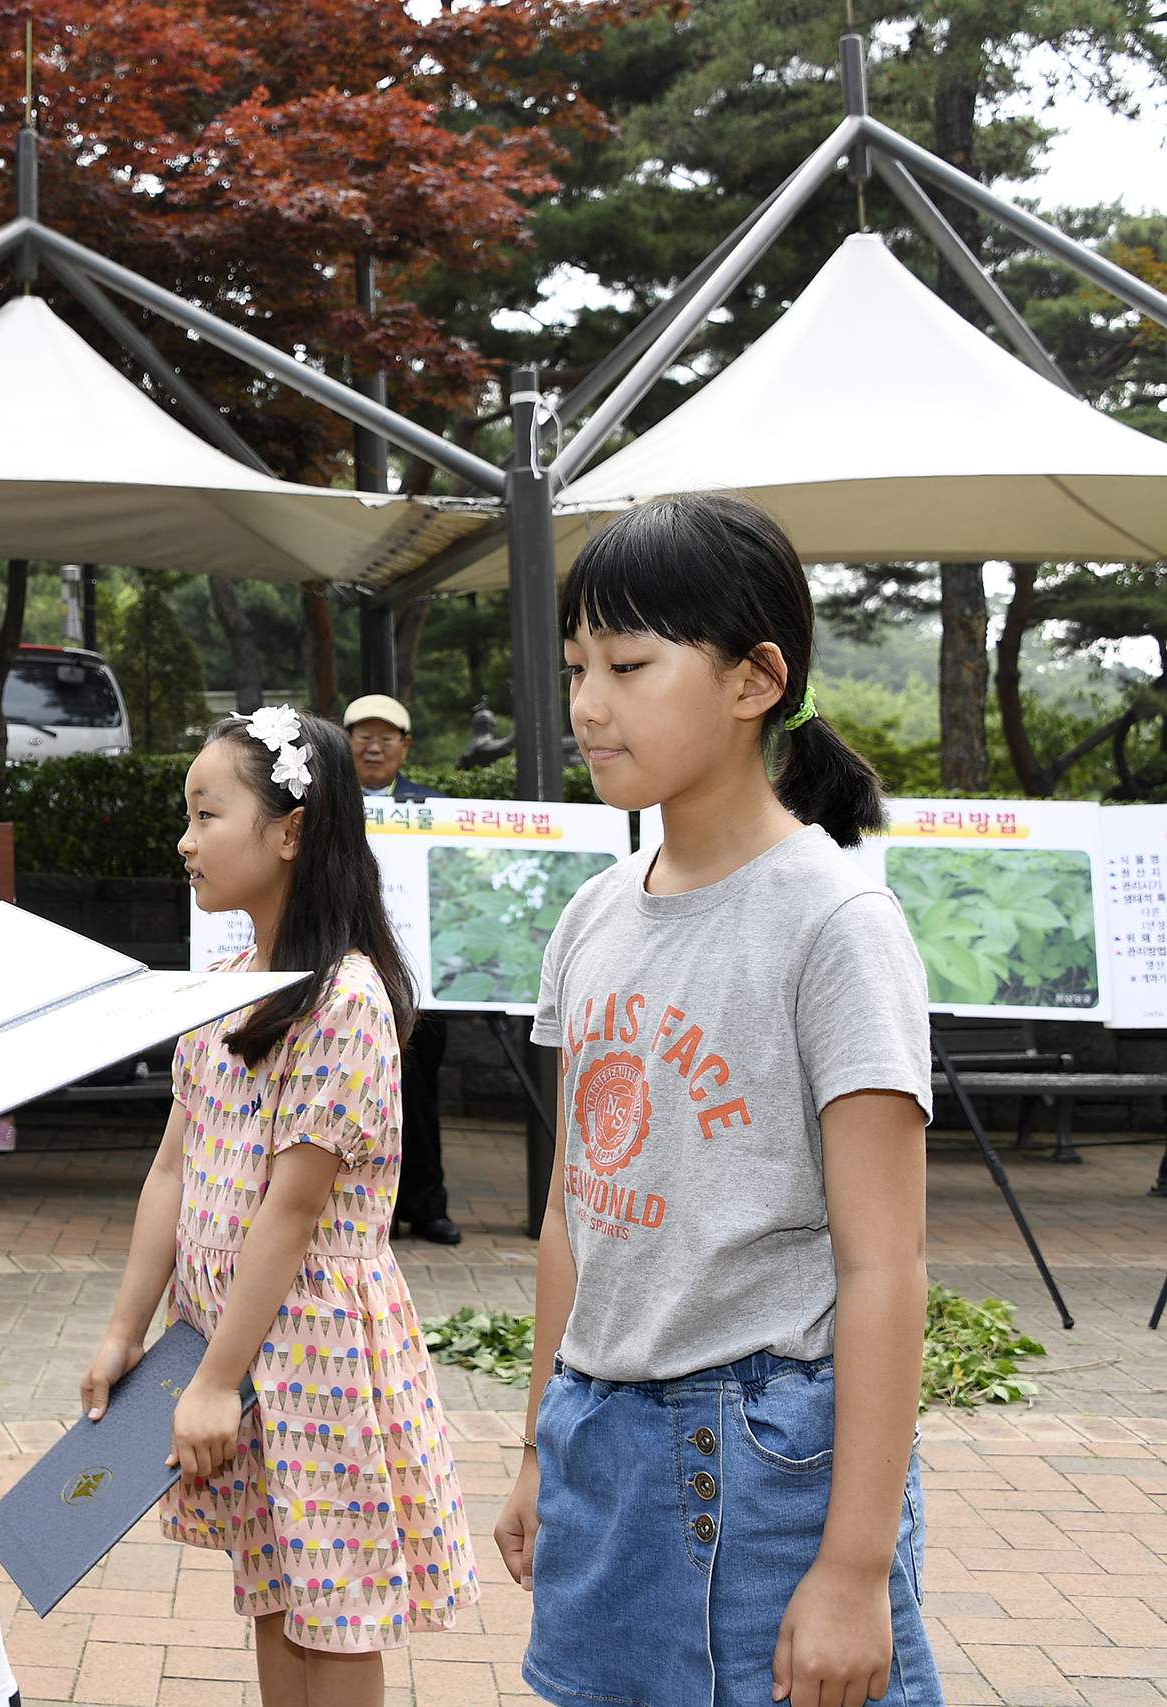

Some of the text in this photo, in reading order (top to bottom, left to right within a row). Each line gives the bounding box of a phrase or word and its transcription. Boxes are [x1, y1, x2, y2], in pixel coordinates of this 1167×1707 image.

[455, 808, 552, 835] 관리방법
[914, 810, 1019, 835] 관리방법
[650, 1004, 752, 1140] FACE
[589, 1217, 630, 1241] SPORTS
